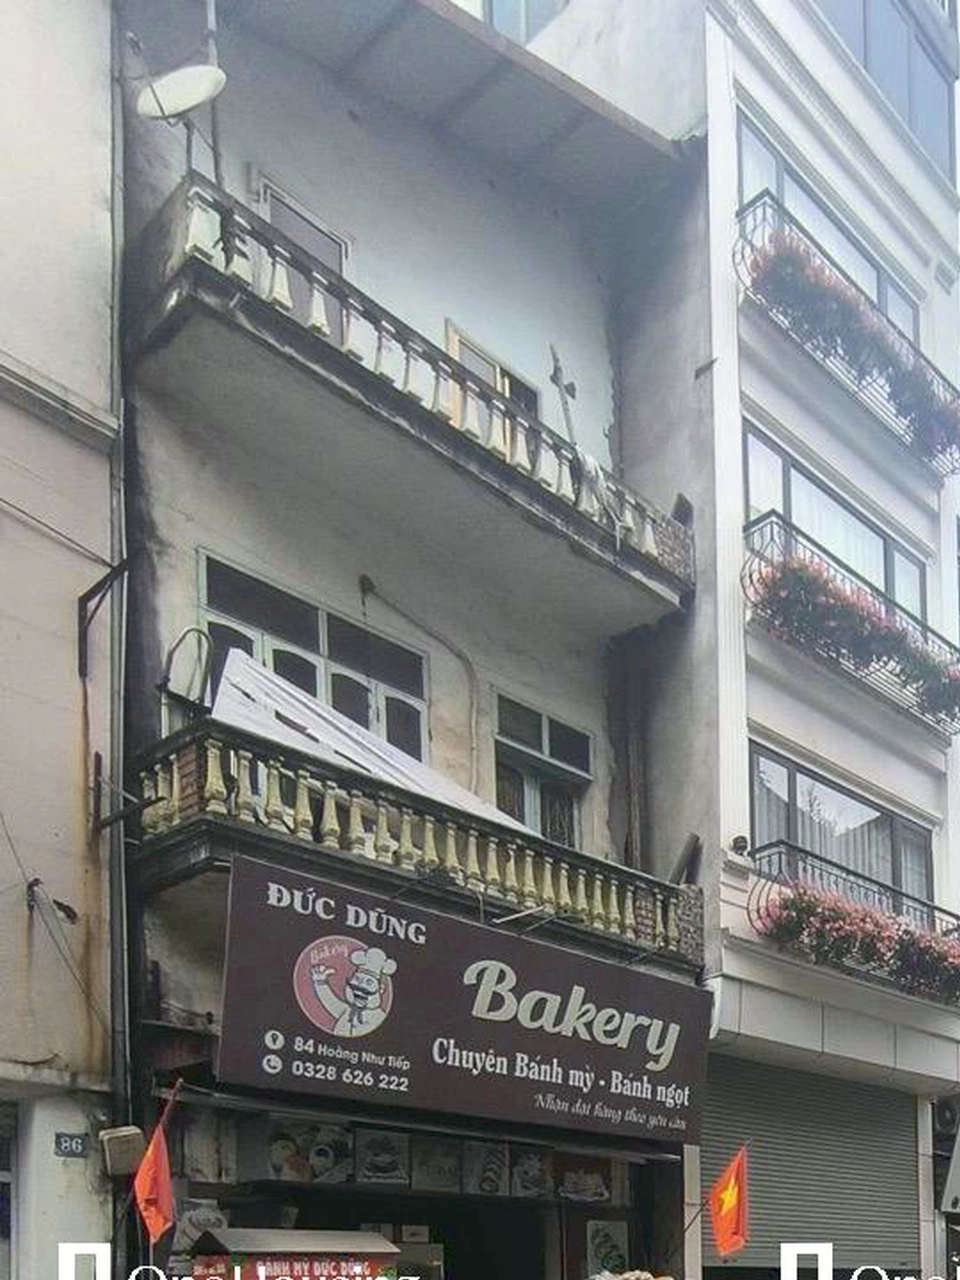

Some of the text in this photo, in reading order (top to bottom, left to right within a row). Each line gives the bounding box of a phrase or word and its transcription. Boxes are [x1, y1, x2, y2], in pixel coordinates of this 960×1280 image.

[266, 882, 428, 945] ĐỨC DŨNG
[463, 959, 681, 1072] Bakery
[293, 1036, 315, 1054] 84
[317, 1043, 359, 1065] Hoàng
[361, 1051, 387, 1066] Như
[431, 1037, 508, 1076] Chuyên
[515, 1053, 563, 1086] Bánh
[610, 1069, 653, 1100] Bánh
[655, 1084, 690, 1109] ngọt
[291, 1060, 410, 1092] 0328 626 222
[60, 1137, 84, 1154] 86
